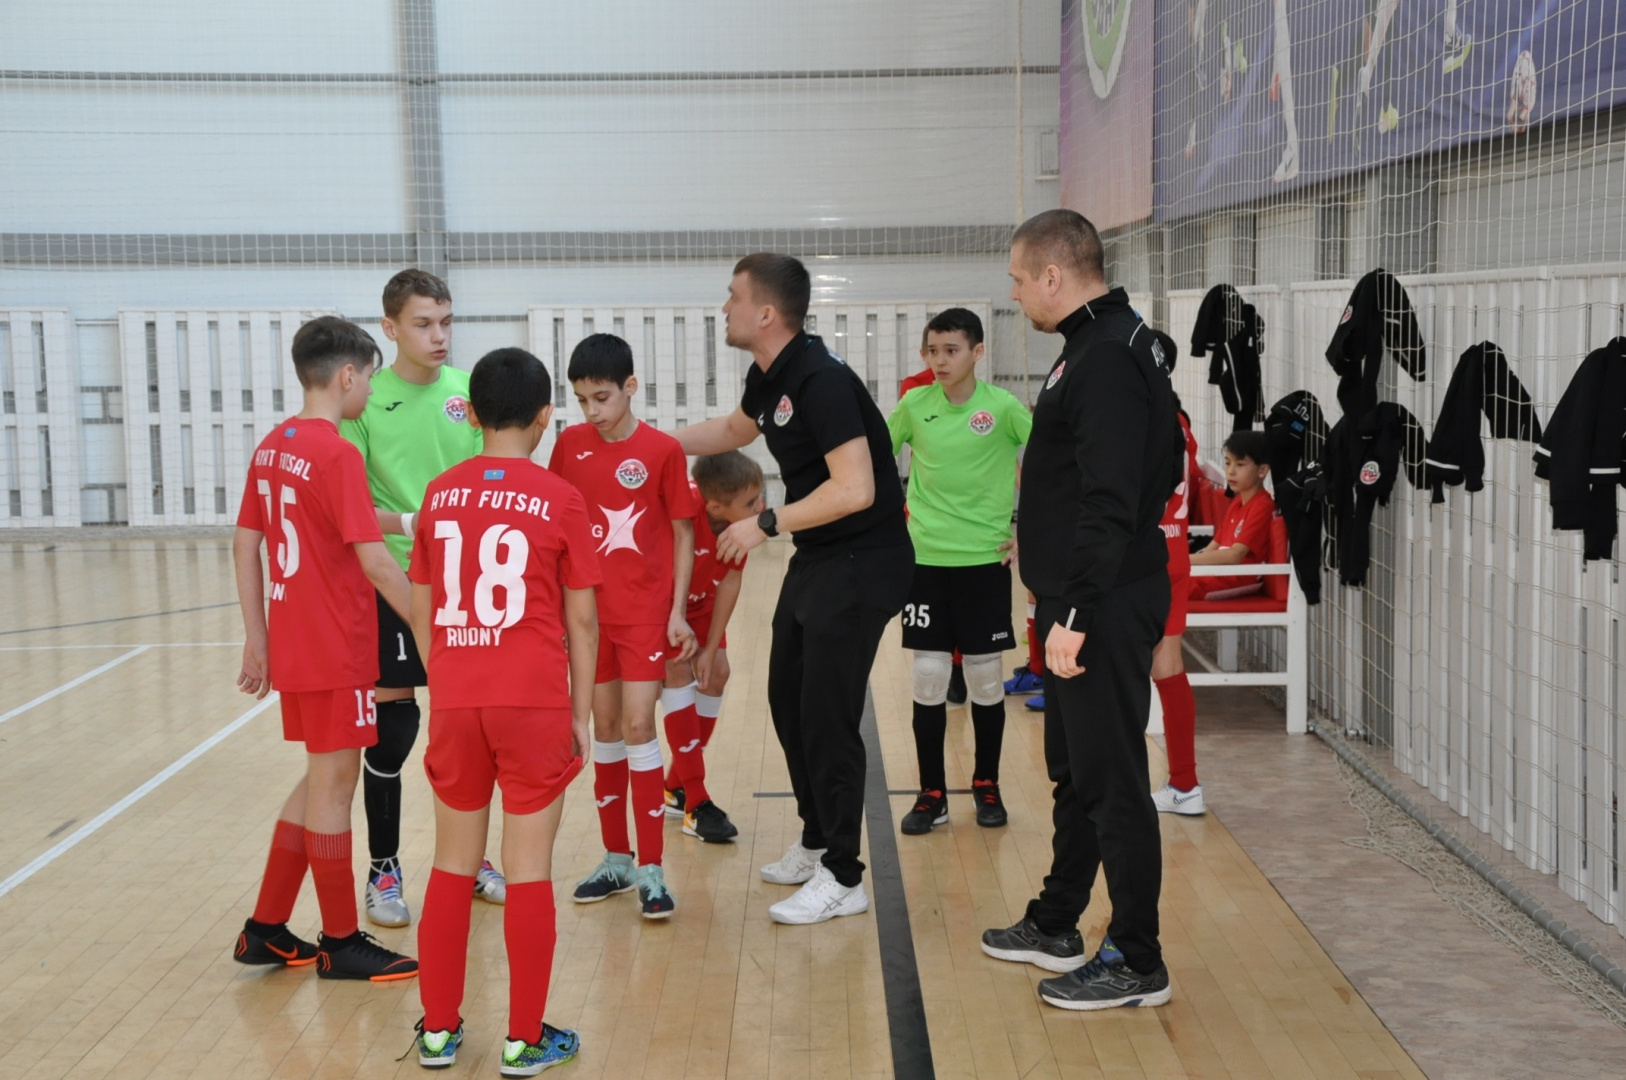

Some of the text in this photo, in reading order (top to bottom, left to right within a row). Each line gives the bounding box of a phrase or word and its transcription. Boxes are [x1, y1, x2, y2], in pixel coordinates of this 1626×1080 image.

[430, 488, 551, 522] AYAT FUTSAL
[434, 520, 529, 629] 18
[903, 603, 930, 628] 35
[397, 632, 407, 661] 1
[446, 626, 503, 647] RUDNY
[355, 689, 377, 727] 15
